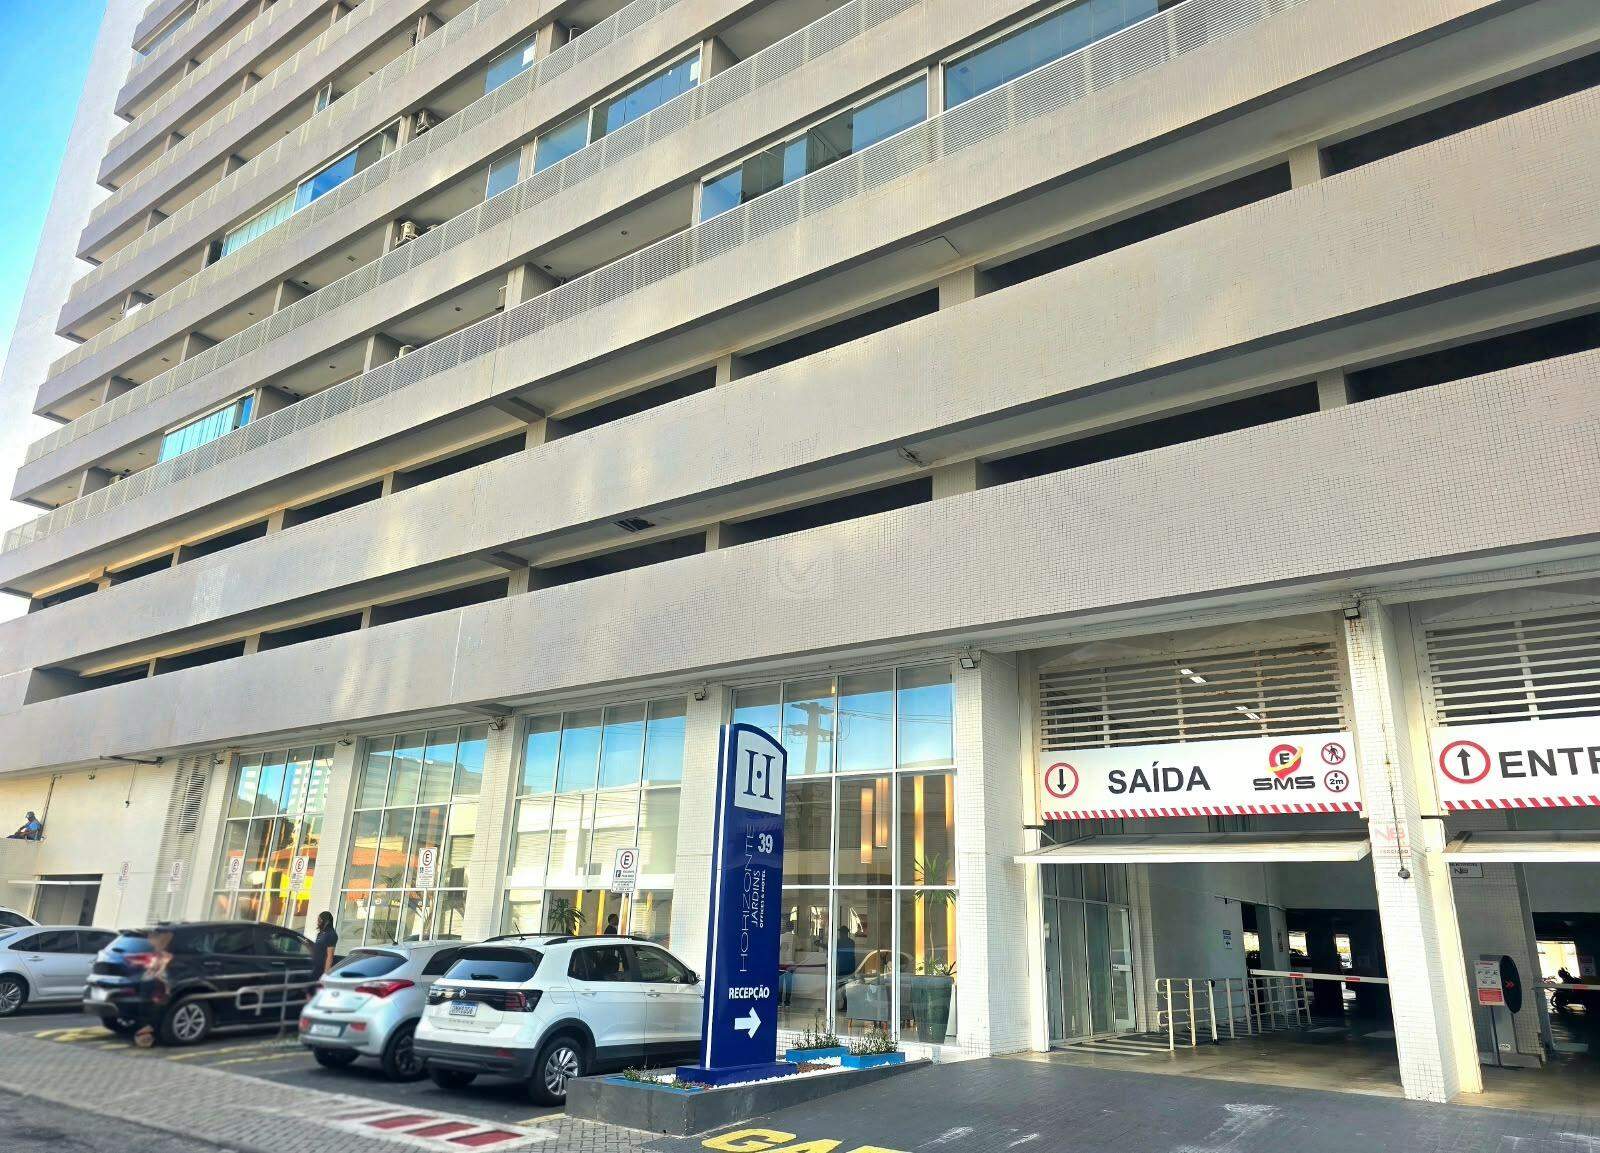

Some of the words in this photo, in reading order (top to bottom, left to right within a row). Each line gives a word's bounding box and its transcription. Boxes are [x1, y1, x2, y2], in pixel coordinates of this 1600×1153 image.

[1279, 752, 1290, 765] E
[1108, 761, 1211, 794] SAÍDA
[1253, 775, 1316, 791] SMS
[758, 833, 773, 854] 39
[623, 855, 630, 866] E
[740, 823, 755, 972] HORIZONTE
[751, 870, 761, 928] JARDINS
[728, 985, 770, 1001] RECEPÇÃO
